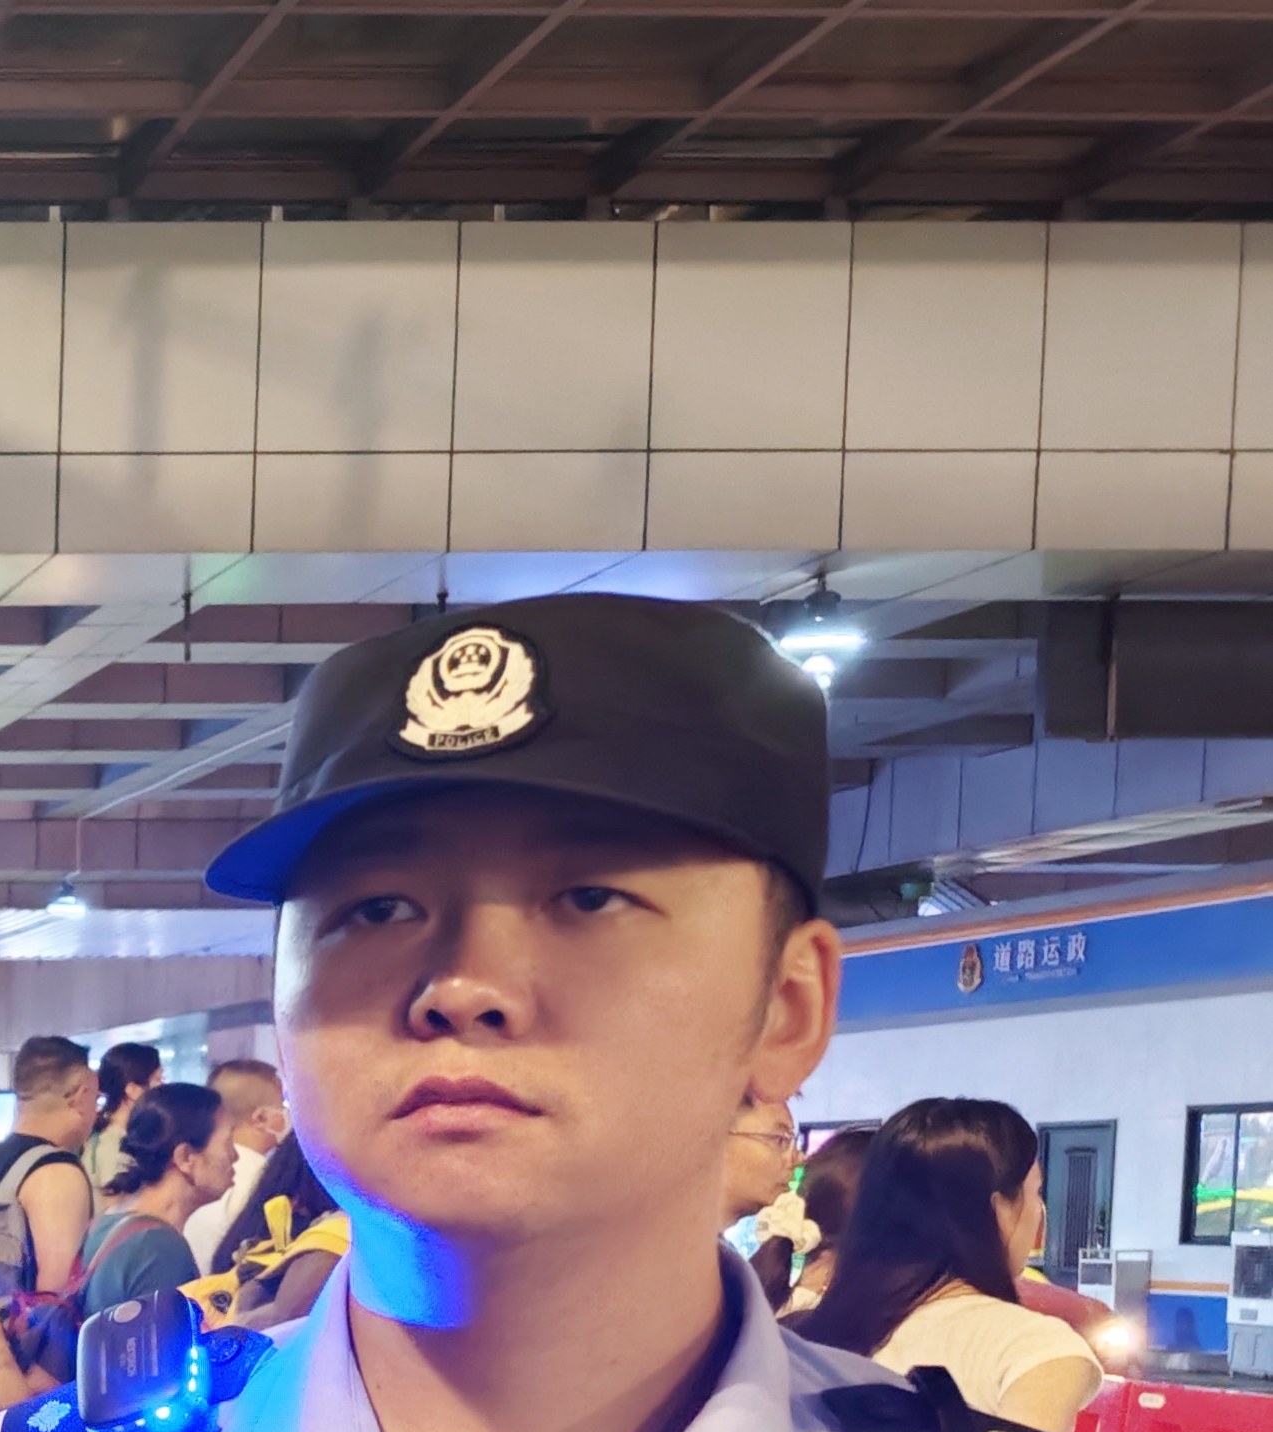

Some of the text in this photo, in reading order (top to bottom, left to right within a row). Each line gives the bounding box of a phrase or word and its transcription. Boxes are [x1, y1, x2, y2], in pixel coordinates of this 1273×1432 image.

[434, 728, 497, 748] POLICE
[993, 931, 1088, 973] 道路运政
